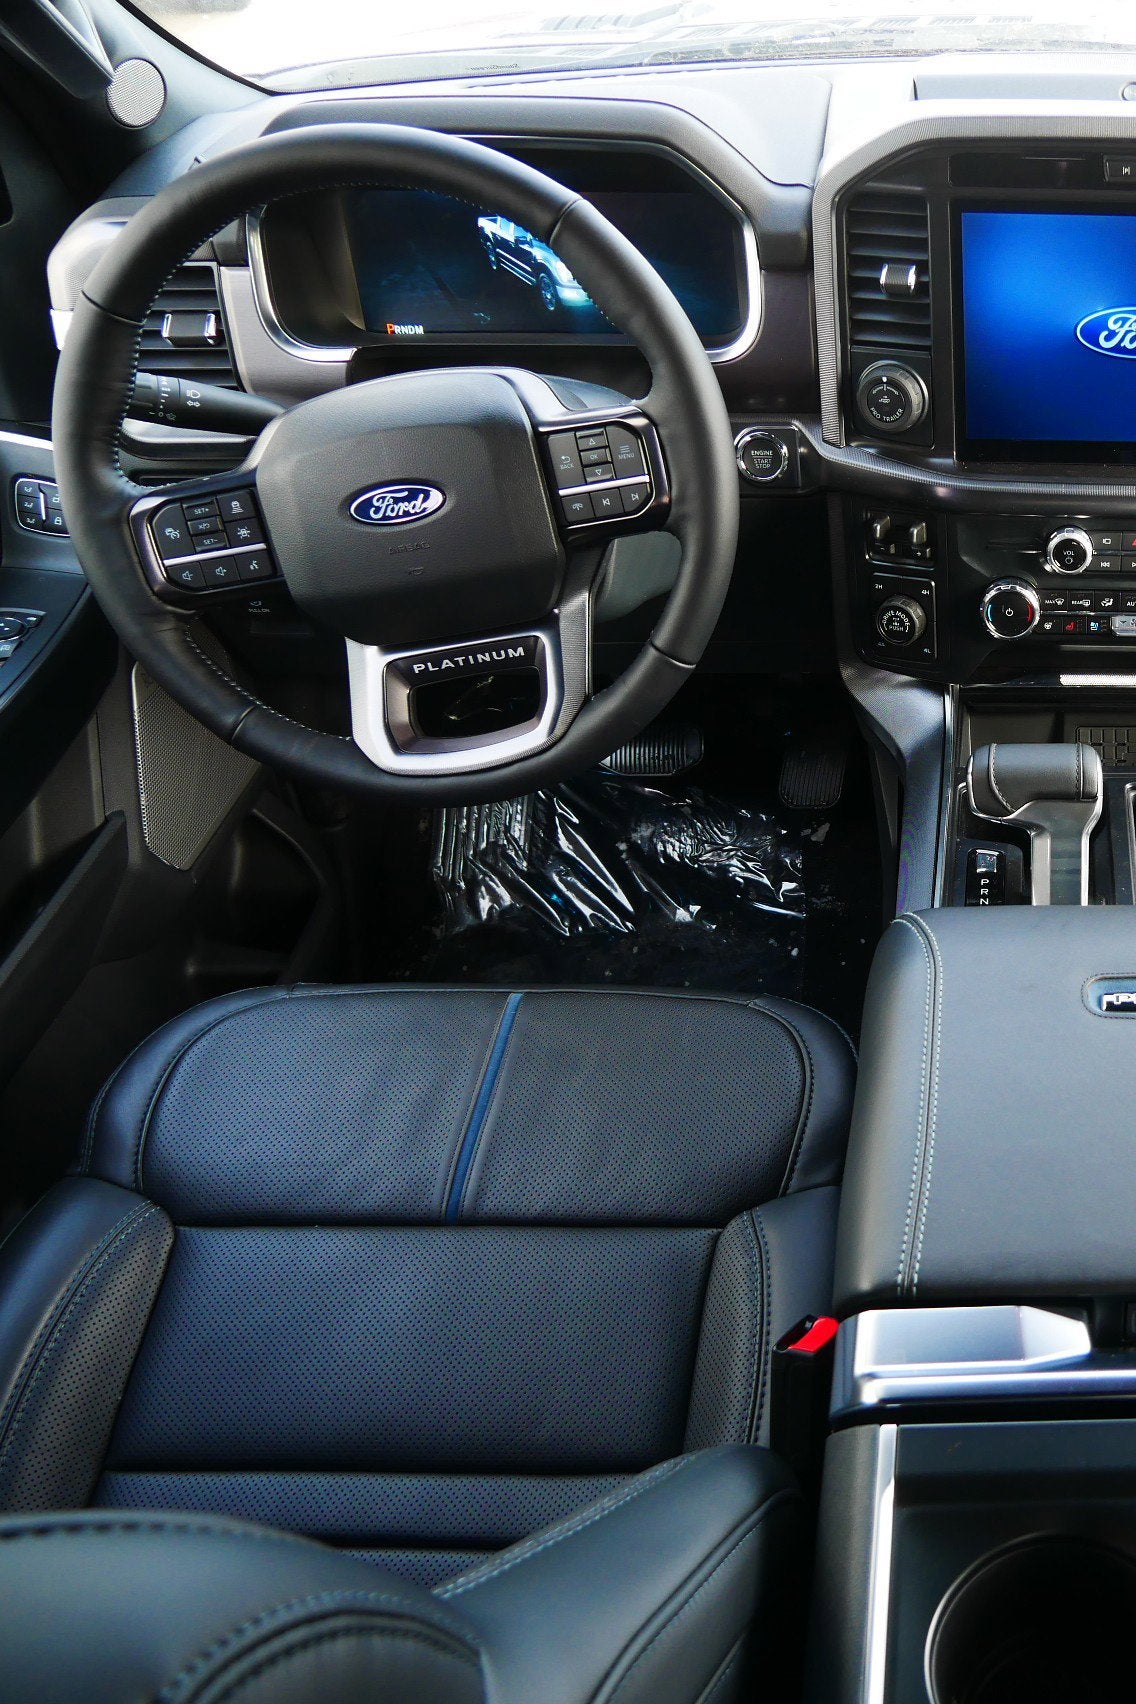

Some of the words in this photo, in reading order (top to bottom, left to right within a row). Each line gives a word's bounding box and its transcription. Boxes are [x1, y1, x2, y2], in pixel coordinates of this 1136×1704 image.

[869, 406, 881, 419] PRO
[882, 407, 904, 422] TRAILER
[617, 451, 635, 460] MENU
[560, 461, 574, 470] BACK
[194, 507, 210, 515] SET+
[412, 646, 526, 674] PLATINUM
[980, 878, 990, 886] P
[980, 888, 989, 896] R
